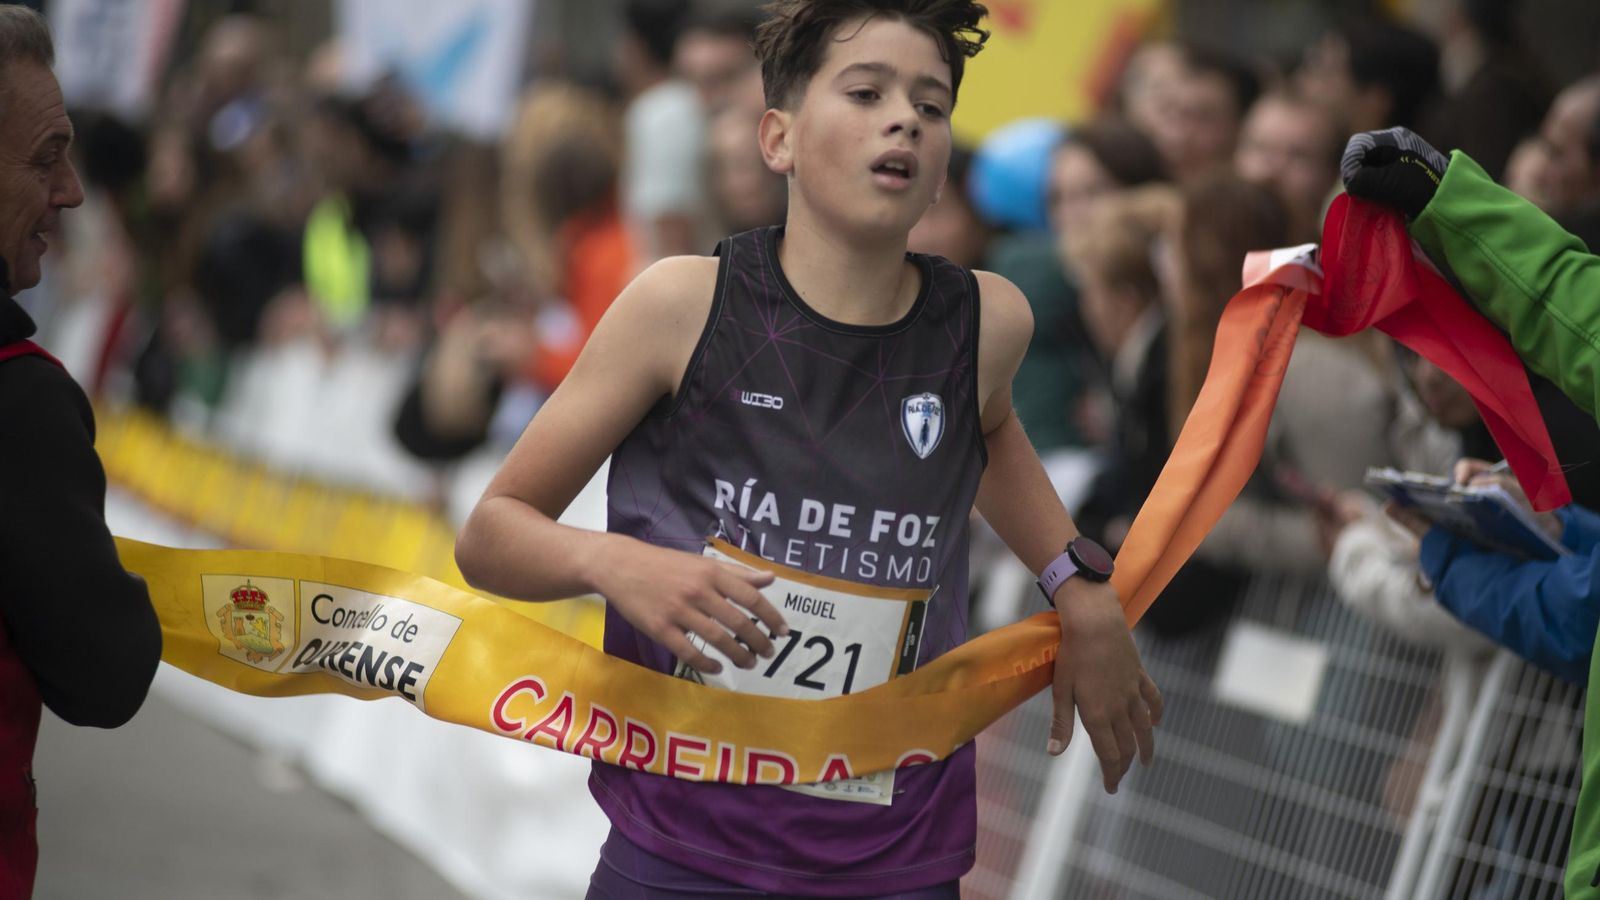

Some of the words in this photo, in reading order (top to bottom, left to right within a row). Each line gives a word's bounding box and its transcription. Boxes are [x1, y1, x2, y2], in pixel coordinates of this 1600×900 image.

[714, 478, 781, 527] RÍA
[797, 498, 856, 538] DE
[869, 509, 941, 548] FOZ
[713, 519, 932, 584] ATLETISMO
[311, 593, 388, 631] Concello
[390, 613, 418, 643] de
[784, 592, 836, 620] MIGUEL
[292, 638, 425, 702] OURENSE
[734, 617, 863, 695] 721
